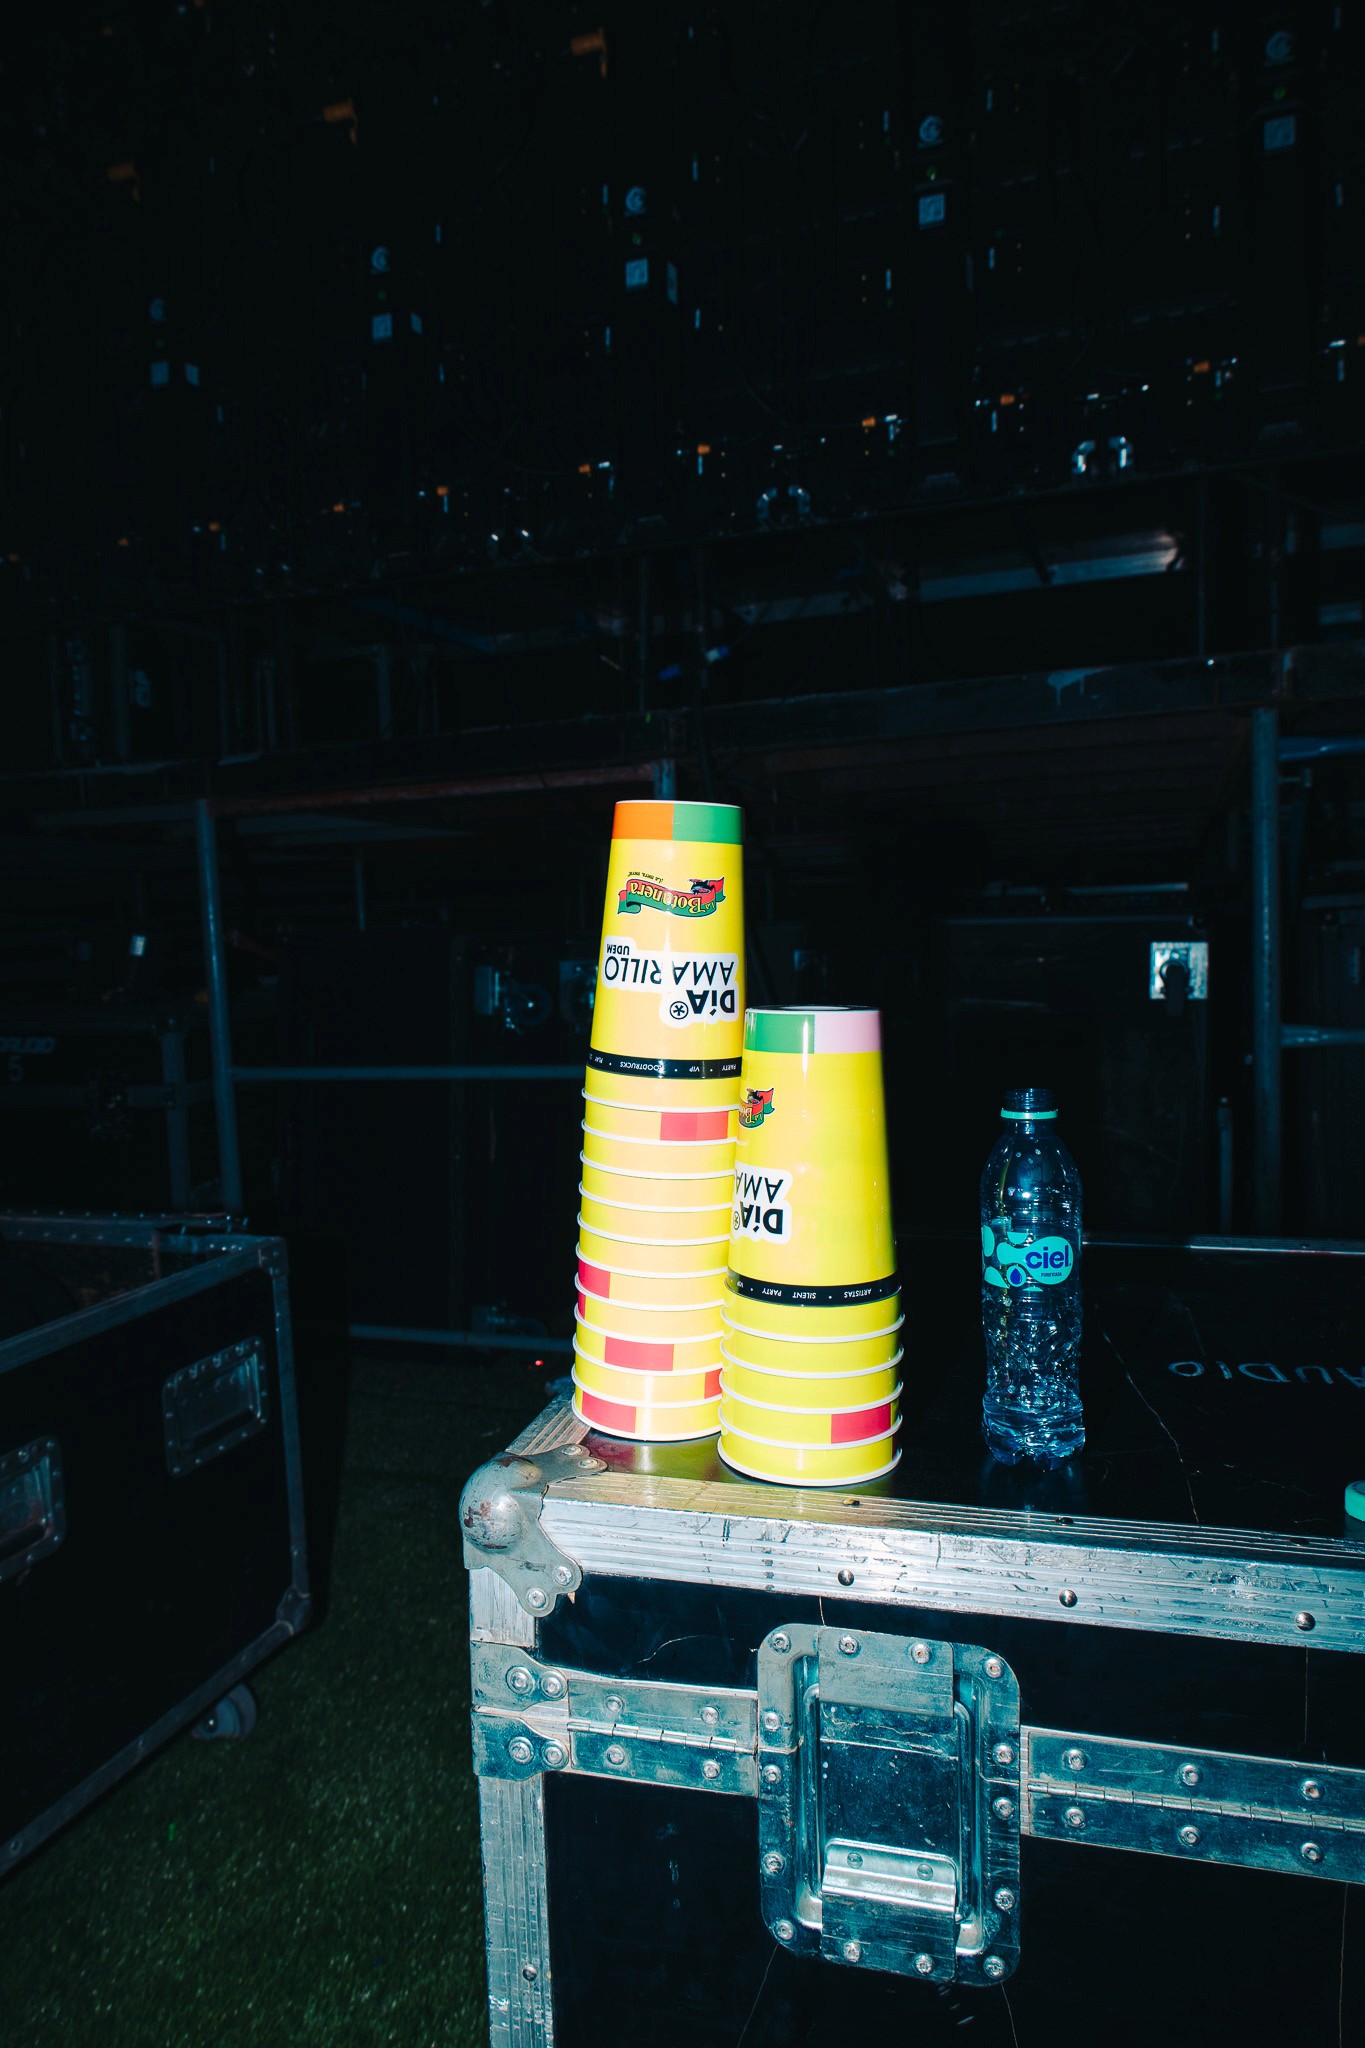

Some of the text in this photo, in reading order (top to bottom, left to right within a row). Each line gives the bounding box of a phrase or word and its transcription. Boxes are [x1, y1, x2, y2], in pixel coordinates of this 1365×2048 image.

[629, 882, 706, 914] Botanera
[606, 943, 630, 956] UDEM
[619, 1061, 663, 1073] OODTRUCKS
[721, 1063, 737, 1072] PARTY
[1025, 1244, 1069, 1269] ciel
[736, 1280, 872, 1299] ARTISTAS SILENT PARTY VIP
